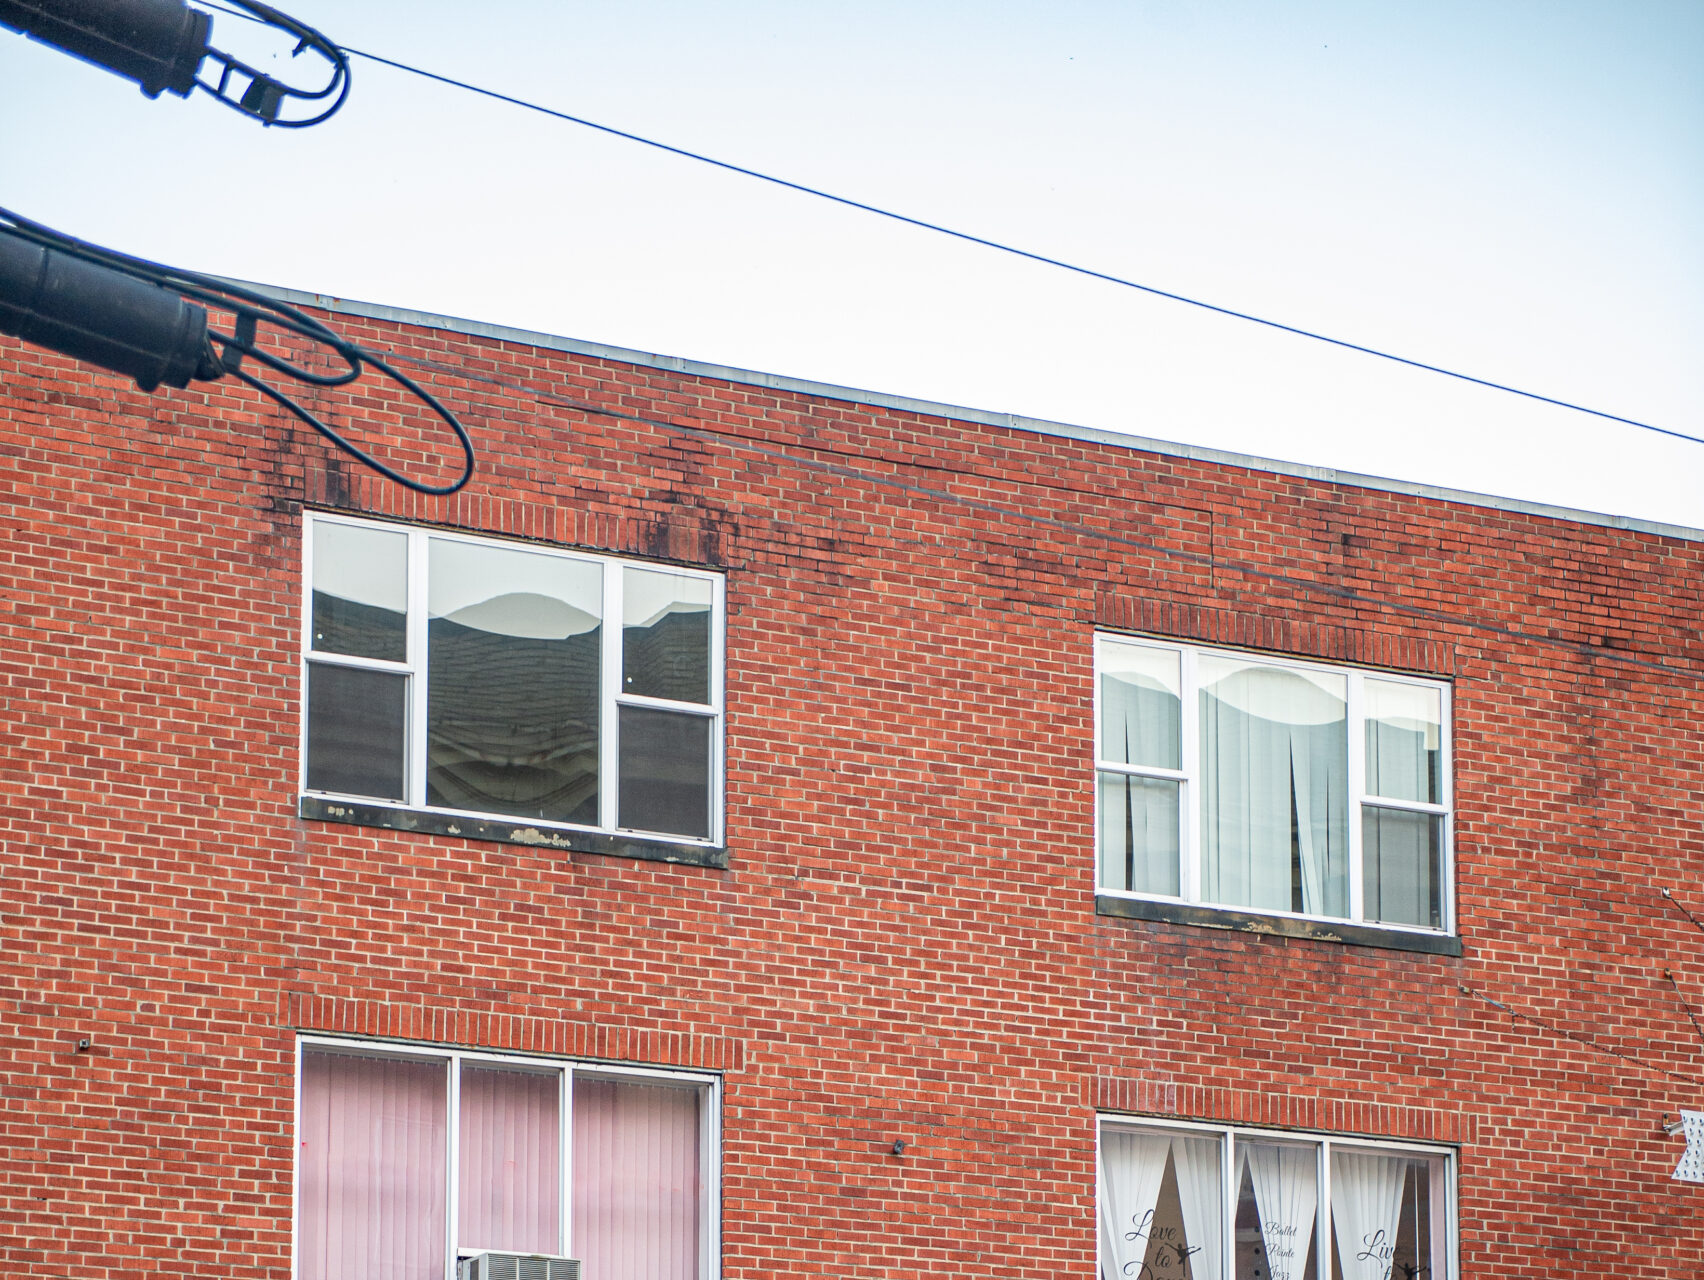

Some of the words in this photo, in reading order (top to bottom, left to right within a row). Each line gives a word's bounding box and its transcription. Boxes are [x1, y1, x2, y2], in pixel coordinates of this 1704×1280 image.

[1125, 1209, 1177, 1248] Love
[1265, 1221, 1297, 1237] Ballet
[1155, 1246, 1171, 1268] to
